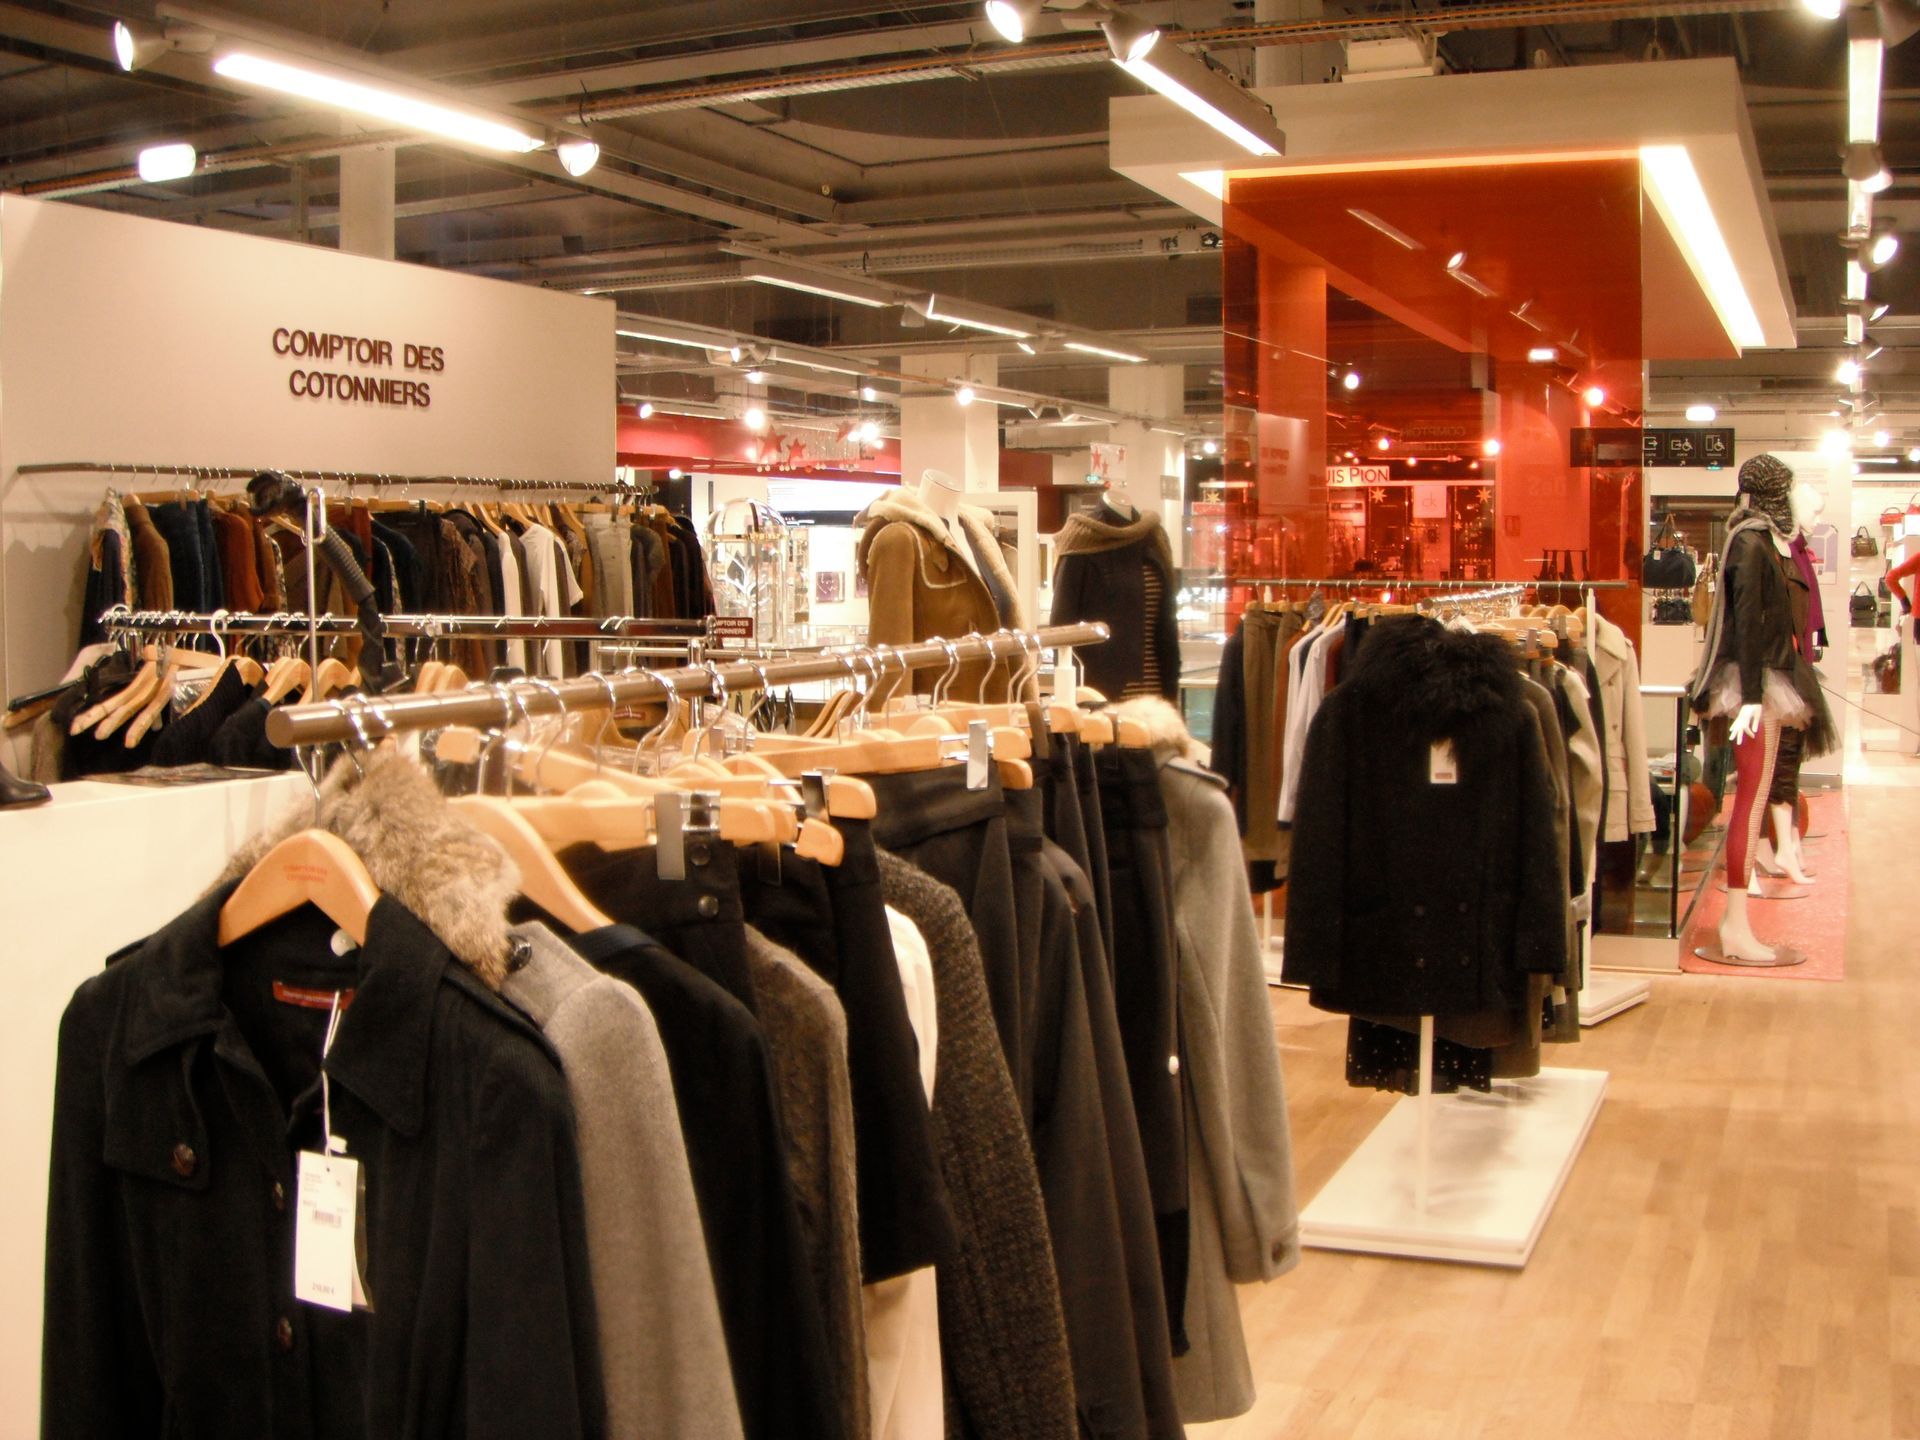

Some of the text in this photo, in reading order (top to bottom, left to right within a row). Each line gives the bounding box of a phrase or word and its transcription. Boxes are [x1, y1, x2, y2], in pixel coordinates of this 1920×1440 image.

[272, 327, 445, 372] COMPTOIR DES
[289, 369, 431, 408] COTONNIERS
[1349, 467, 1388, 483] PION
